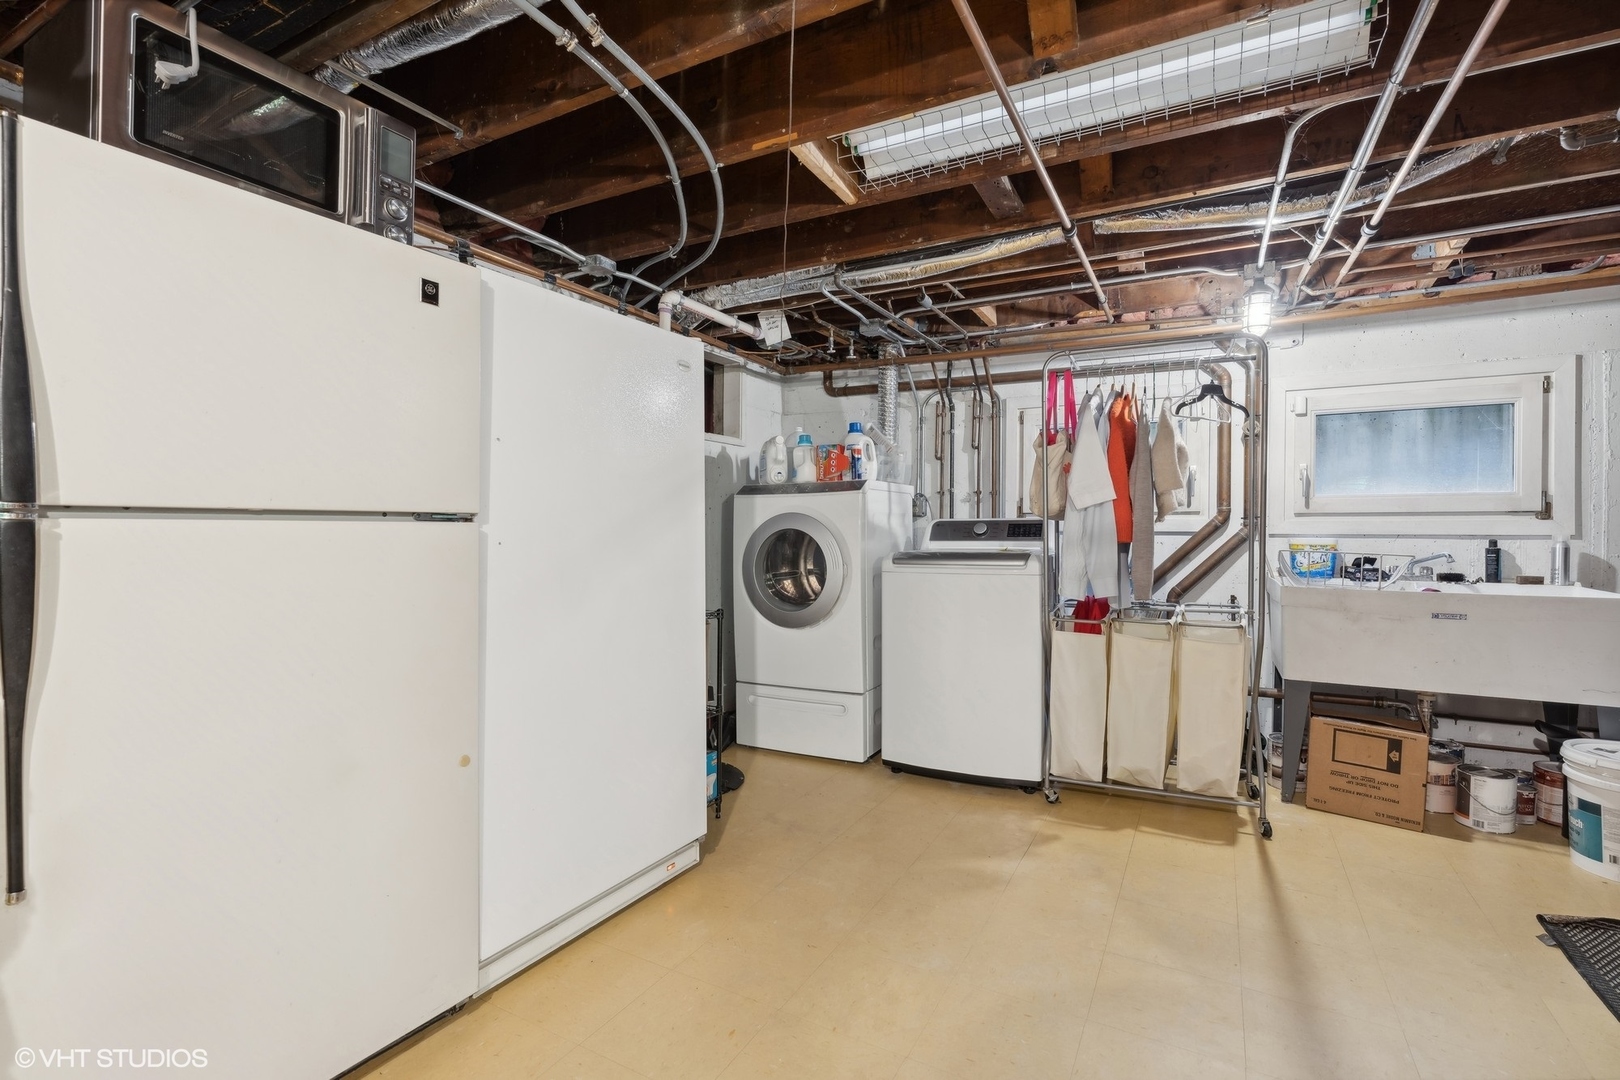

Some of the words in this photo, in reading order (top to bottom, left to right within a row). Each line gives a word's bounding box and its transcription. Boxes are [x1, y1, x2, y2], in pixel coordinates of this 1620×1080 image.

[1330, 771, 1350, 779] THROW
[1328, 786, 1355, 795] FREEZING
[1373, 795, 1400, 804] PROTECT
[1400, 817, 1421, 826] BENJAMIN
